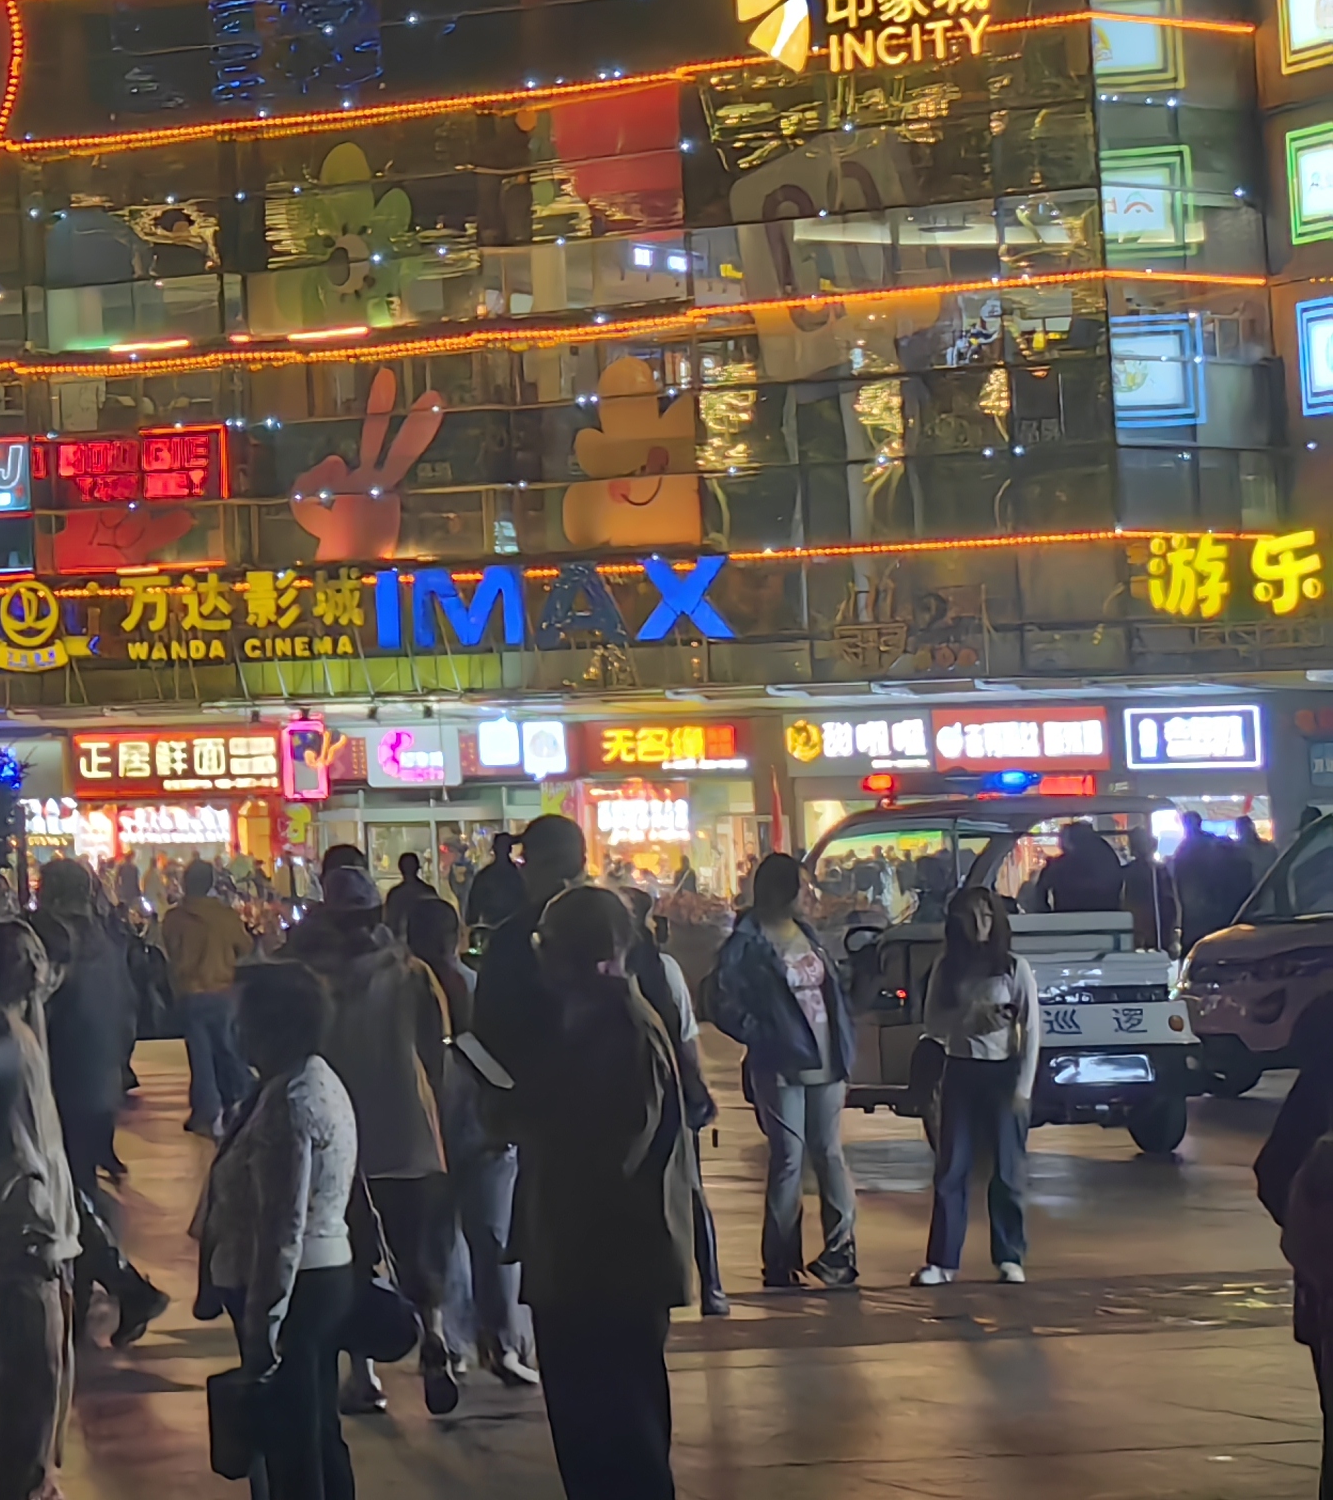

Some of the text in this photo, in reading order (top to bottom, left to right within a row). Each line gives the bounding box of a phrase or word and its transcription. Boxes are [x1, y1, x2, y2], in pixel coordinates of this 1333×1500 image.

[828, 14, 991, 73] INCITY
[119, 566, 365, 633] 万达影城
[376, 555, 736, 649] IMAX
[1147, 529, 1322, 618] 游乐
[127, 634, 354, 661] WANDA CINEMA
[1042, 1007, 1148, 1035] 巡逻
